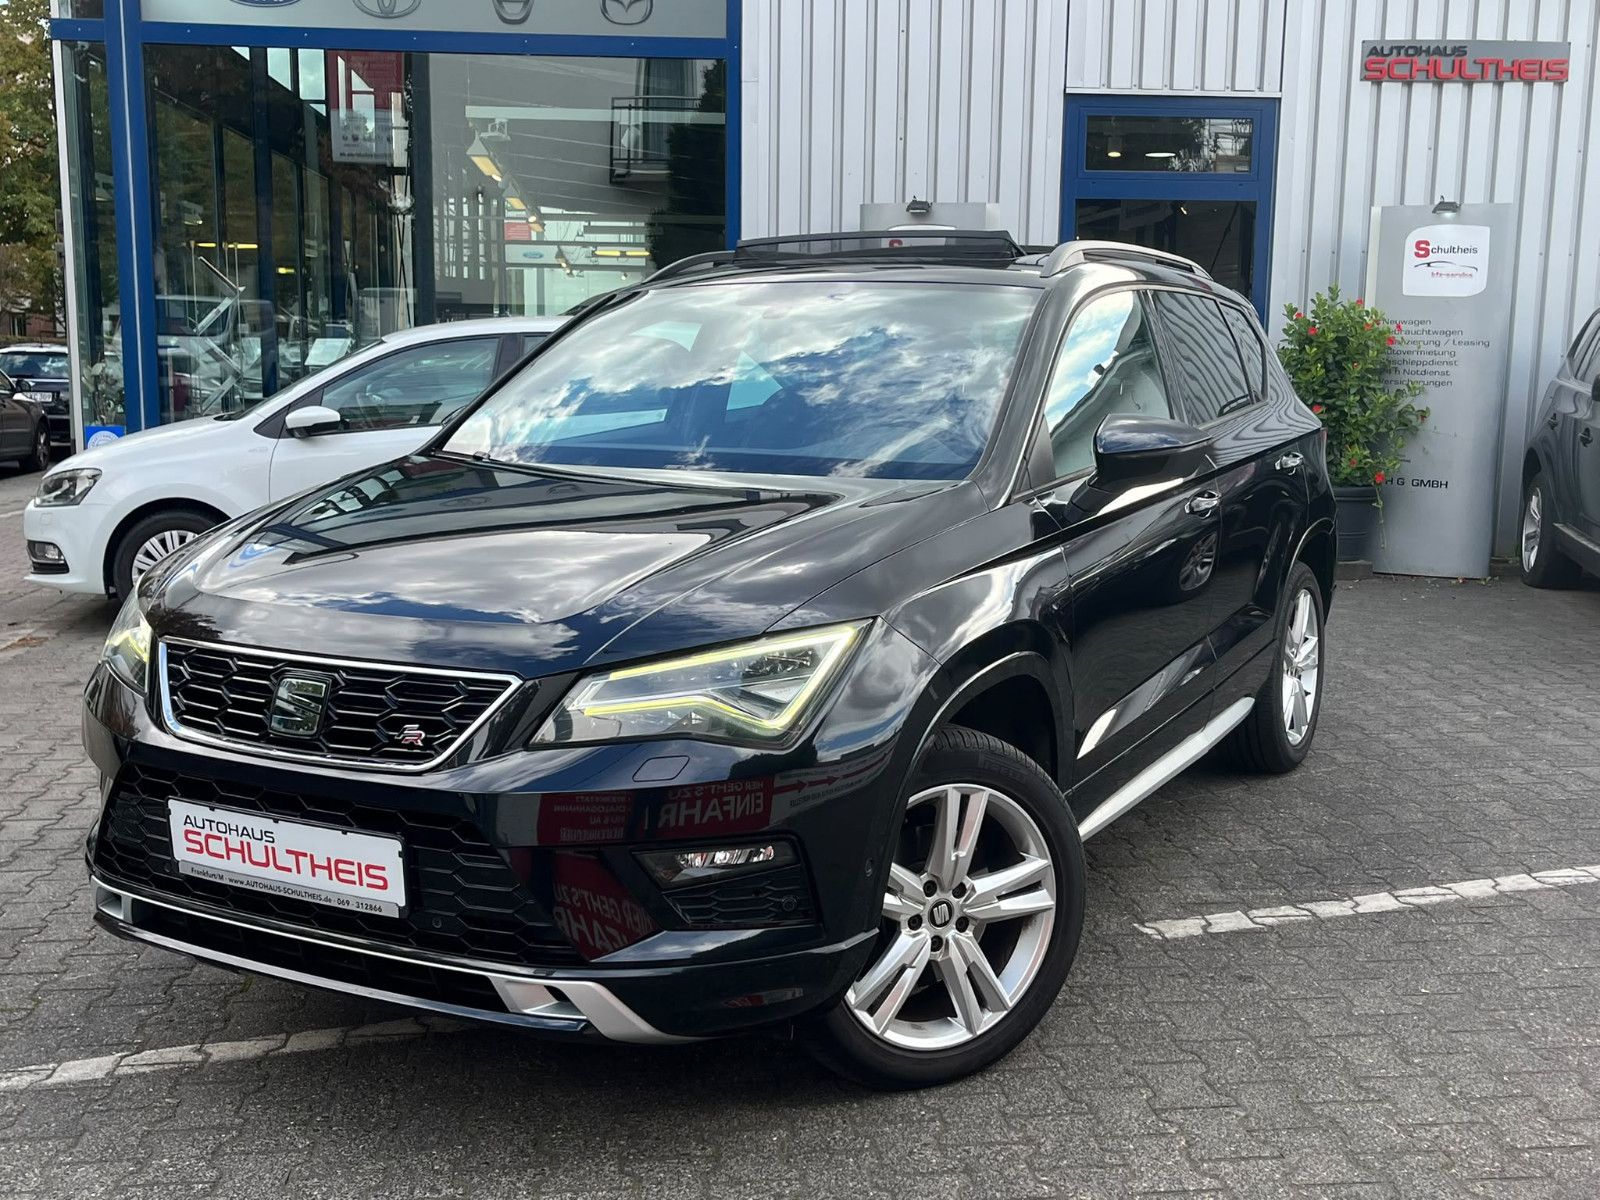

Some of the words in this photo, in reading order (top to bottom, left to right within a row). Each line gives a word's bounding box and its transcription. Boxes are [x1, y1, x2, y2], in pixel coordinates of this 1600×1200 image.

[1366, 45, 1468, 57] AUTOHAUS
[1364, 57, 1569, 81] SCHULTHEIS
[1414, 239, 1478, 258] Schultheis
[1452, 339, 1491, 348] Leasing
[1403, 368, 1451, 376] Notdienst
[1411, 478, 1449, 489] GMBH
[183, 814, 275, 844] AUTOHAUS
[183, 828, 389, 891] SCHULTHEIS
[190, 866, 225, 882] Frankfurt/M
[227, 876, 333, 904] www.AUTOHAUS-SCHULTHEIS.de
[336, 897, 350, 907] 069
[355, 901, 383, 913] 312866
